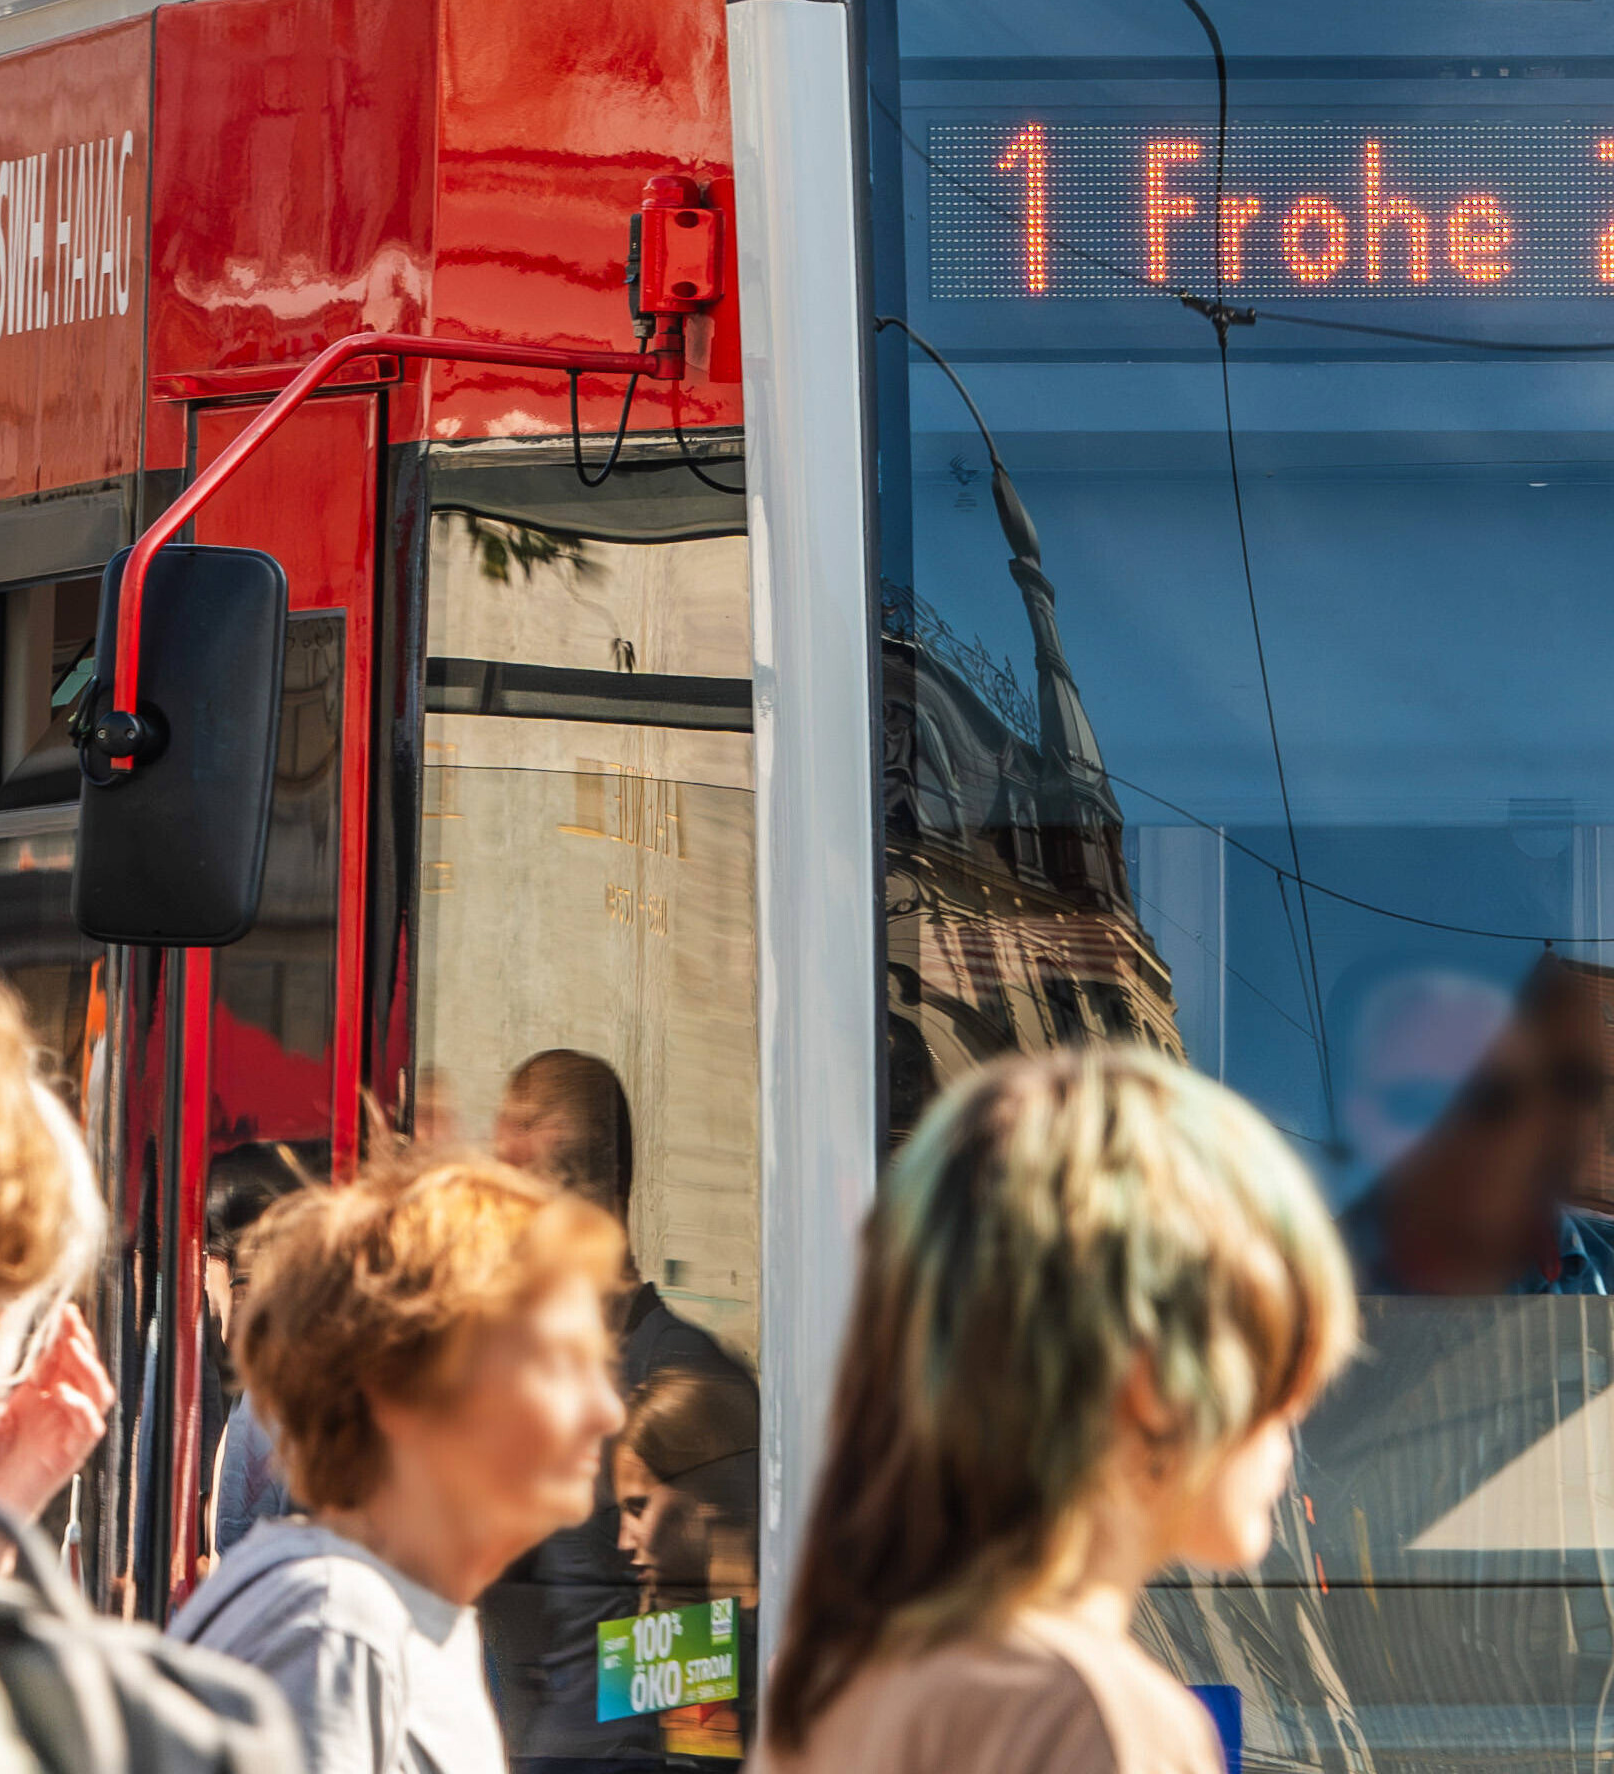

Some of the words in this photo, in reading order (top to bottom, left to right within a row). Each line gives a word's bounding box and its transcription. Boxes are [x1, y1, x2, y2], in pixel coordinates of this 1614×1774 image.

[53, 129, 134, 327] HAVAG
[996, 122, 1048, 295] 1
[1145, 139, 1512, 284] Frohe
[631, 1661, 681, 1711] ÖKO
[686, 1653, 732, 1684] STROM
[633, 1613, 682, 1661] 100%
